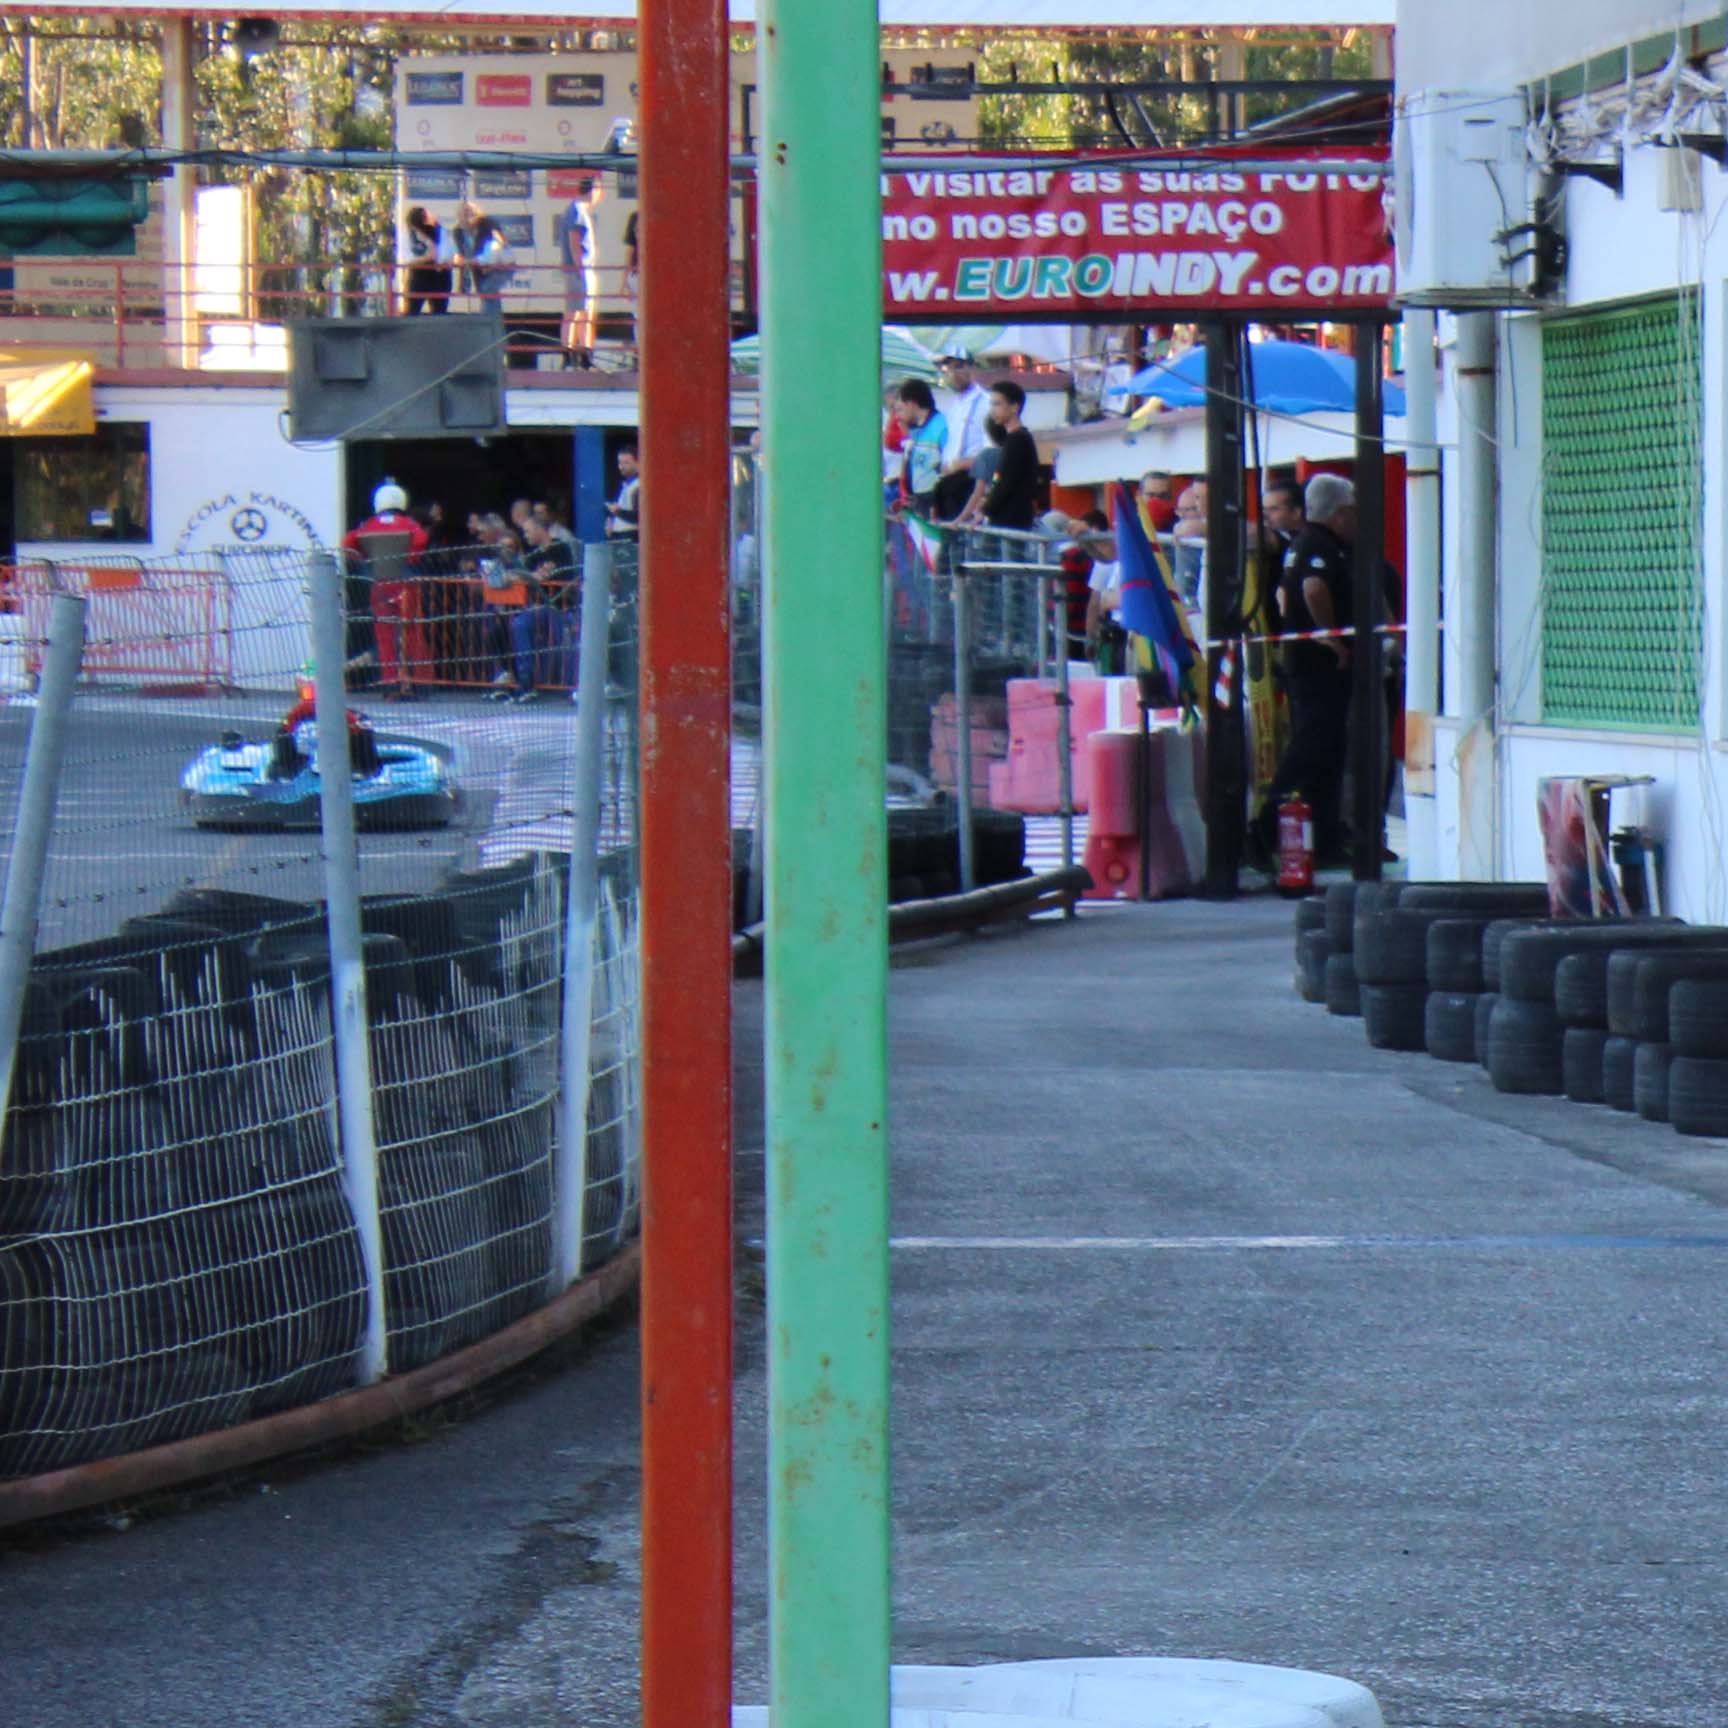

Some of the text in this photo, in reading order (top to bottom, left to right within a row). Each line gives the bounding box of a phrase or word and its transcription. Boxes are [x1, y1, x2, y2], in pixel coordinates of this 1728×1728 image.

[906, 171, 1055, 198] visitar
[1069, 171, 1124, 194] as
[1139, 171, 1246, 193] suas
[882, 201, 1284, 243] no nosso ESPAÇO
